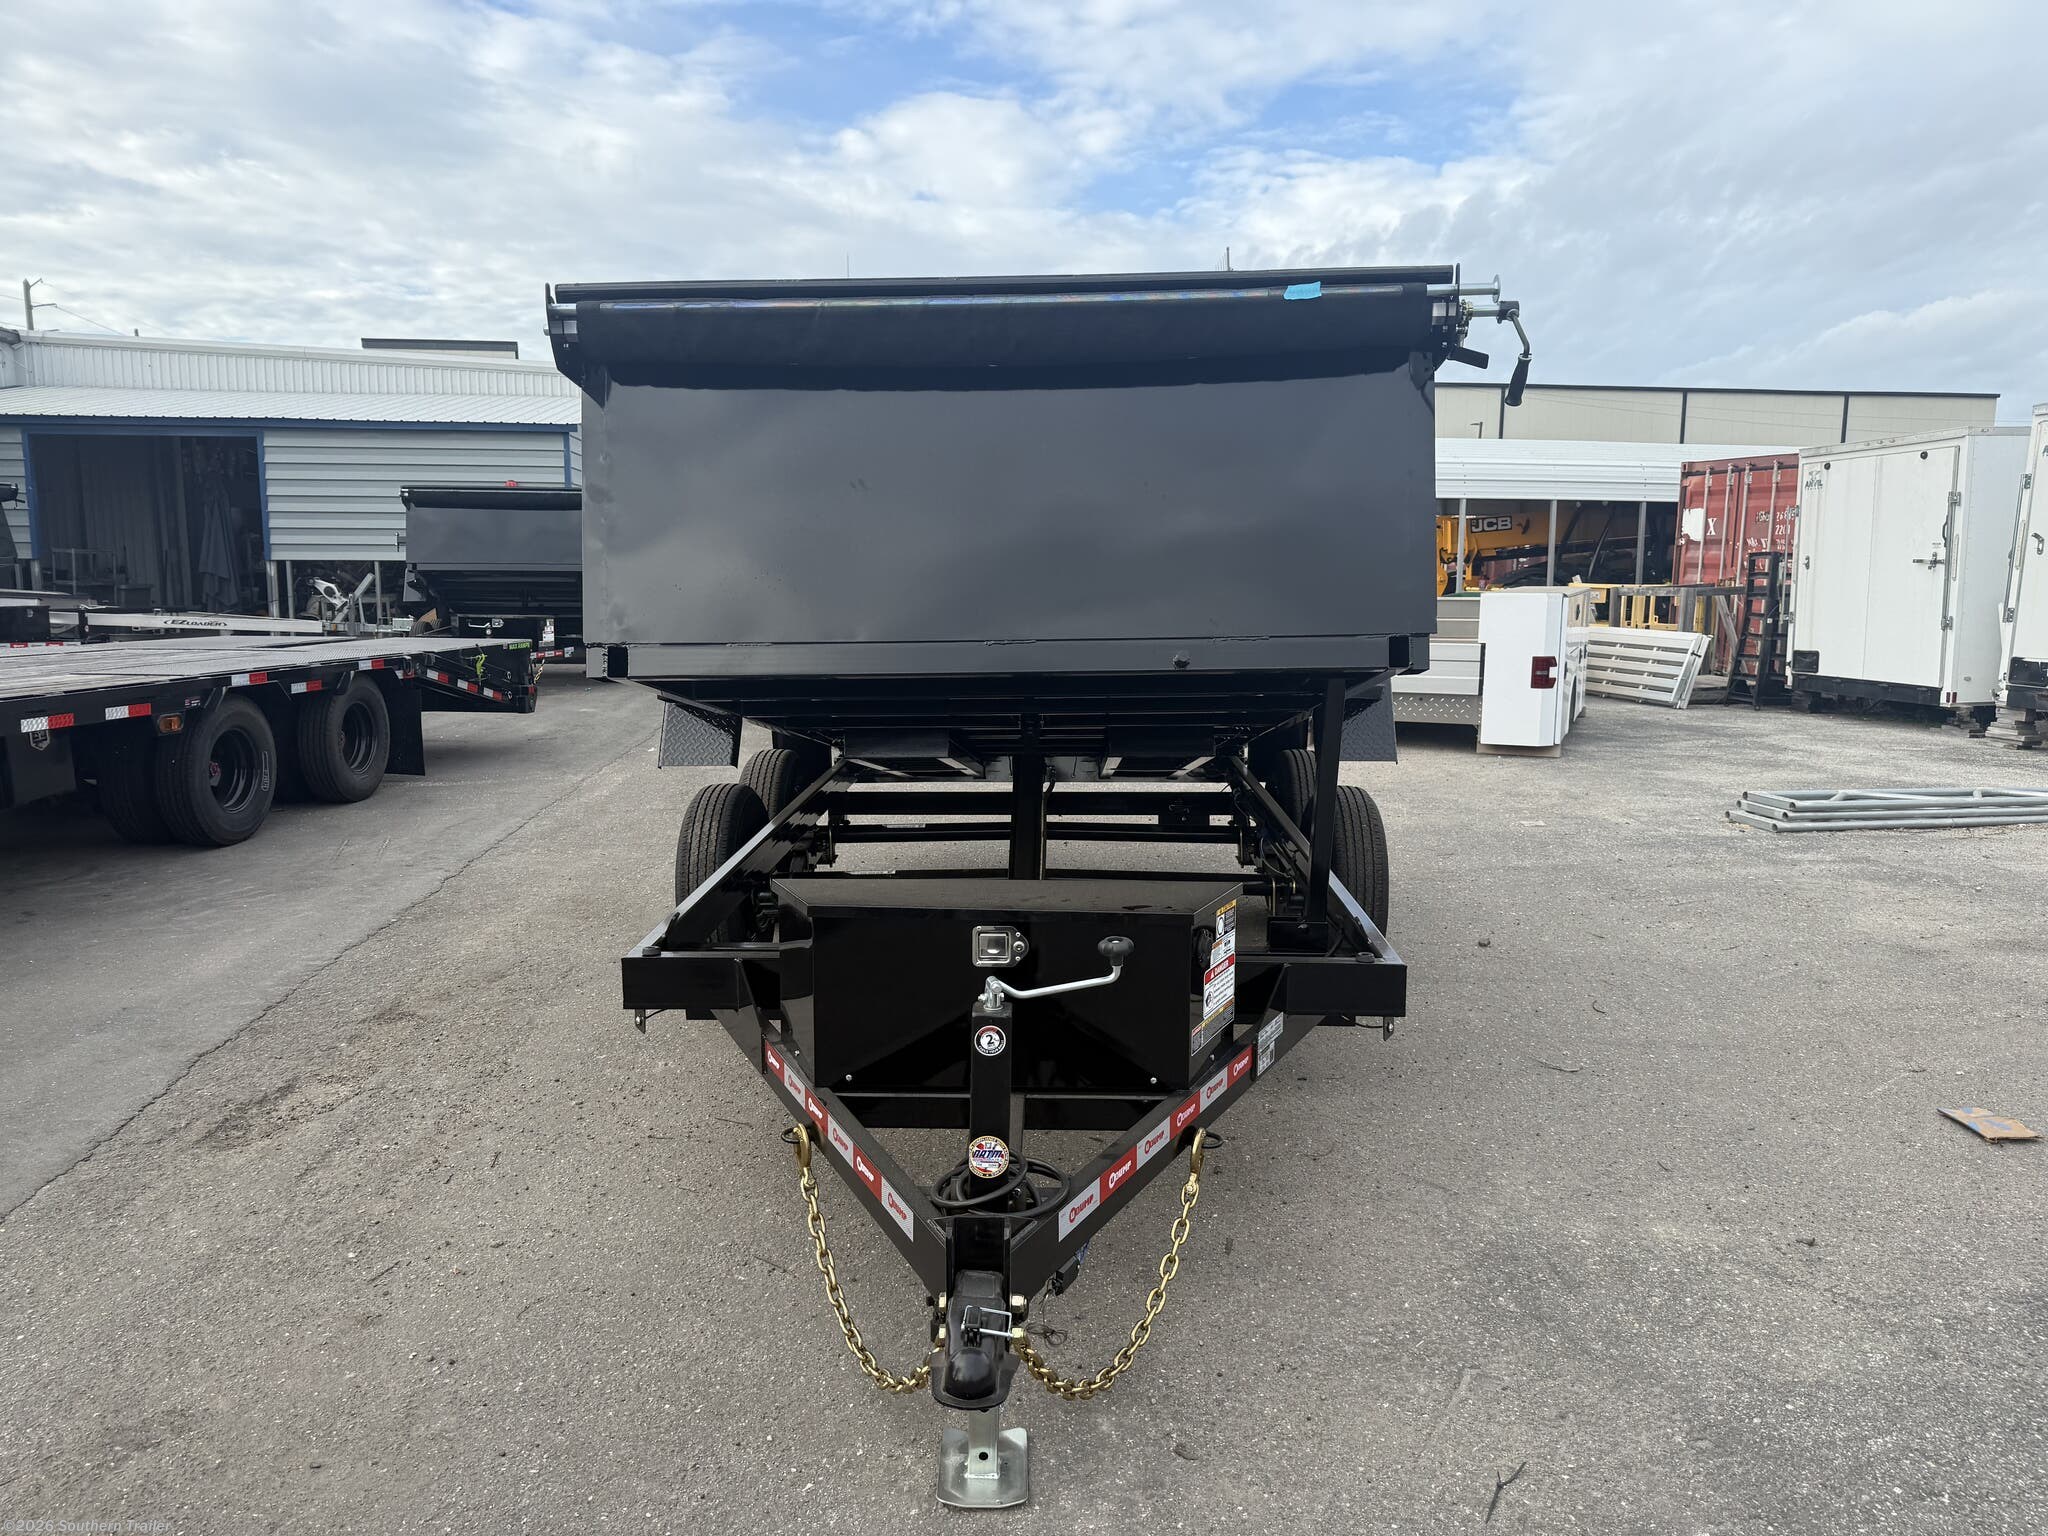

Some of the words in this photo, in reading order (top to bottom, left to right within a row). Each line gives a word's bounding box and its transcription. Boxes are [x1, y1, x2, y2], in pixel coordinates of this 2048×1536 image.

[1471, 517, 1512, 532] JCB
[1706, 518, 1717, 535] X
[985, 1034, 995, 1045] 2
